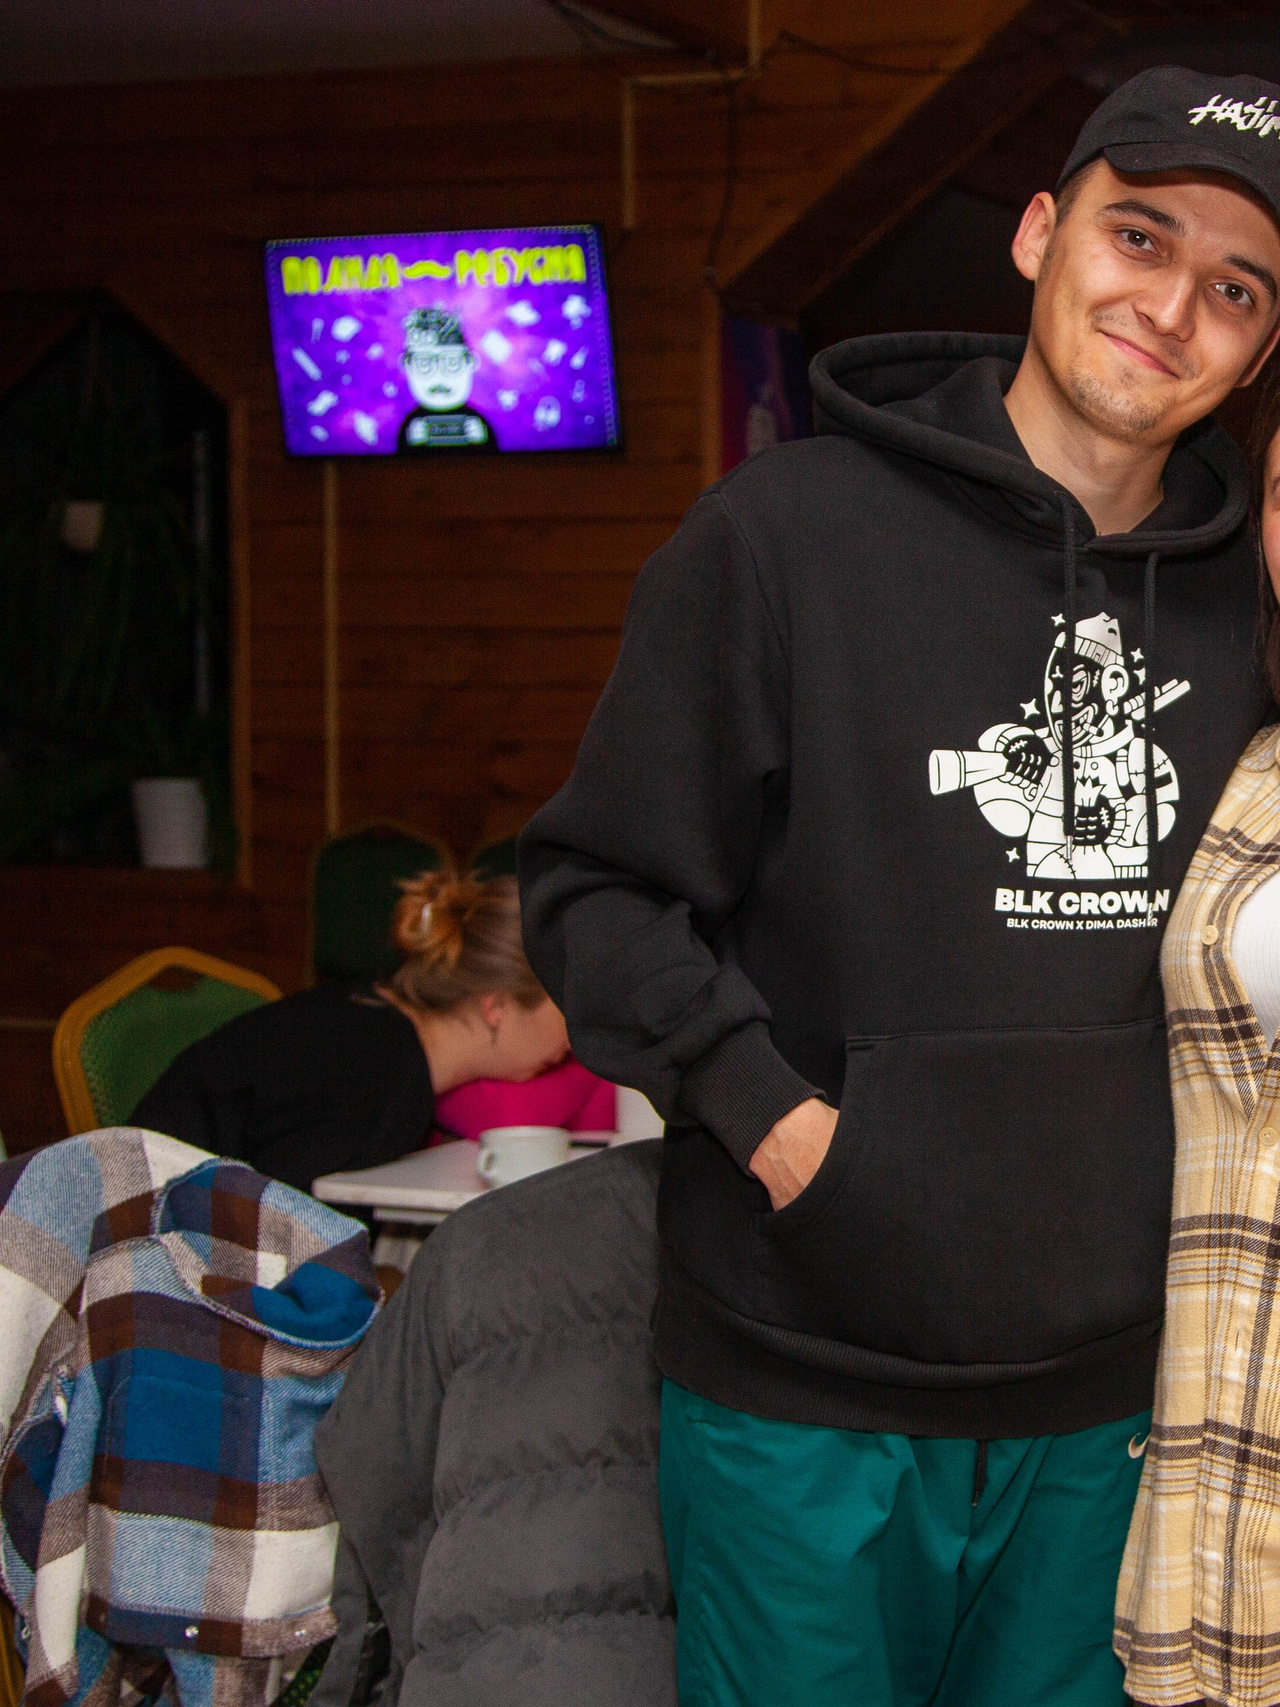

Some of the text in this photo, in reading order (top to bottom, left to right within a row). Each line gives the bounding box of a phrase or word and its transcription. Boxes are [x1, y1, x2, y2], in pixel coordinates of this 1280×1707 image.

[994, 887, 1170, 915] BLK CROWN
[1006, 918, 1158, 930] BLK CROWN X DIMA DASHR
